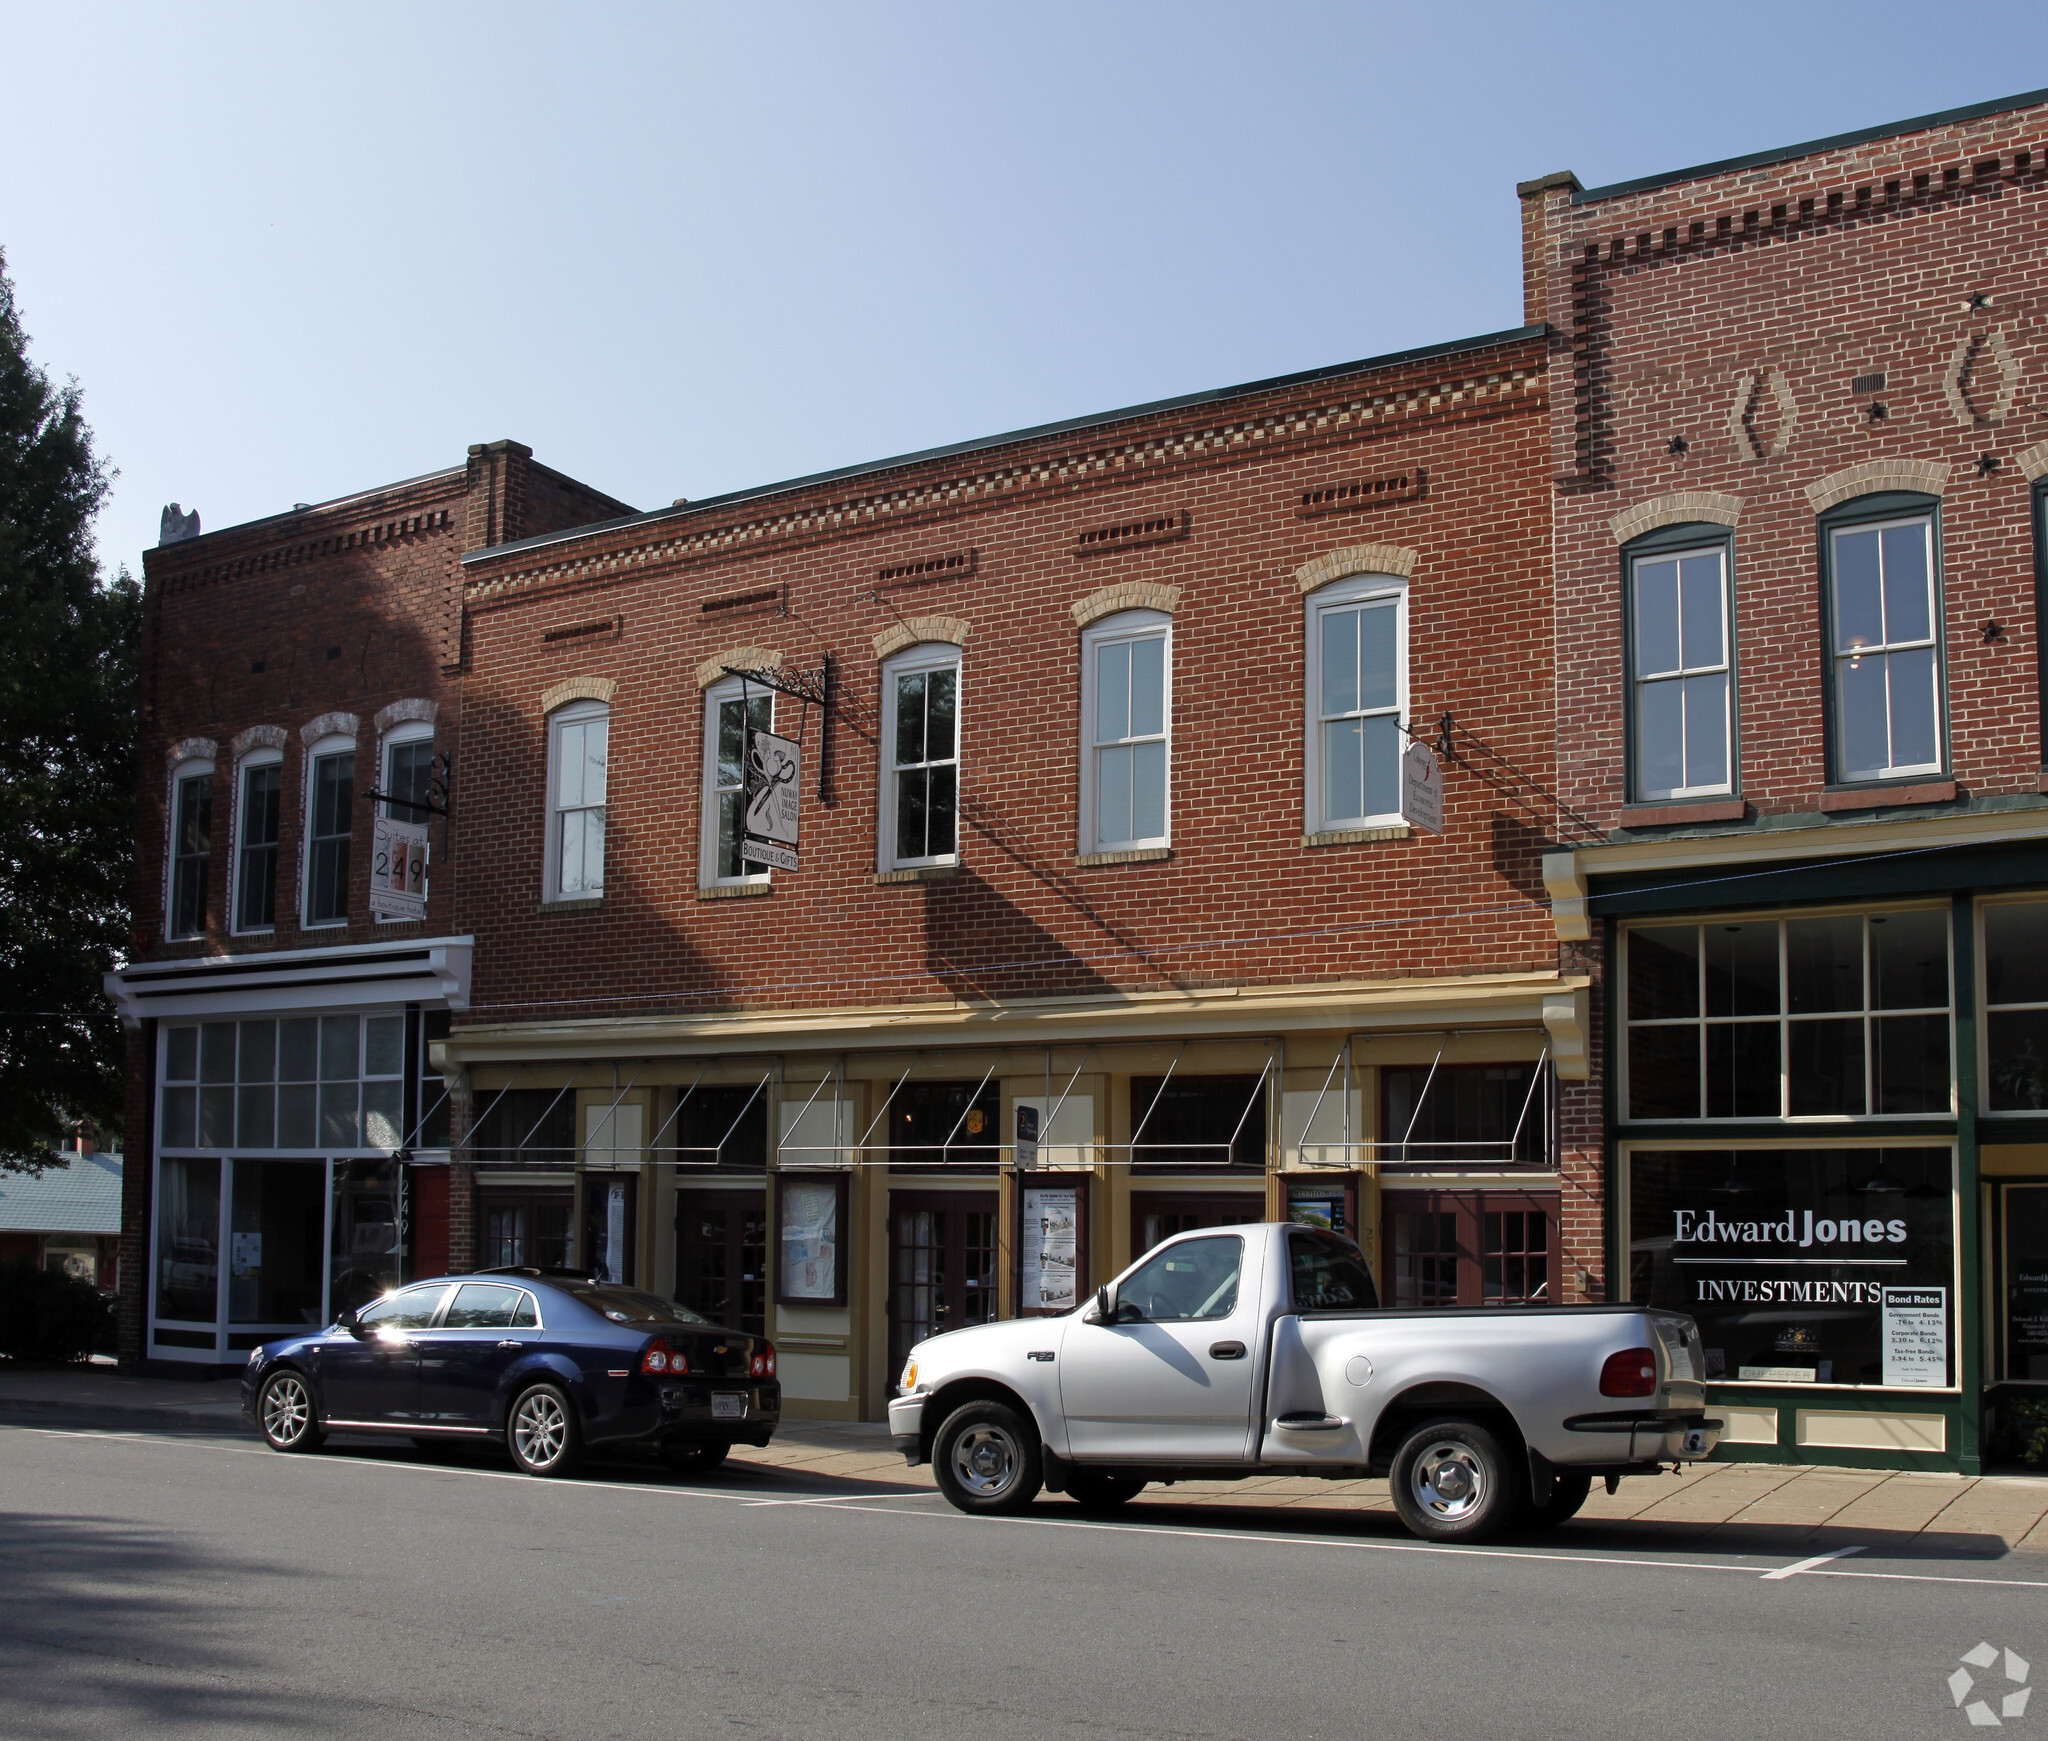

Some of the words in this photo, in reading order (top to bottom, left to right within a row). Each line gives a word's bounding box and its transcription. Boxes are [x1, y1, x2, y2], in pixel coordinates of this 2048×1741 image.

[781, 808, 797, 822] SALON
[782, 798, 797, 812] IMAGE
[376, 820, 410, 843] Suites
[412, 835, 424, 847] at
[376, 852, 422, 882] 249
[744, 842, 774, 862] BOUTIQUE
[775, 853, 780, 862] &
[780, 852, 798, 868] GIFTS
[378, 896, 405, 912] boutique
[401, 1180, 409, 1235] 249
[1697, 1280, 1881, 1304] INVESTMENTS
[1888, 1295, 1911, 1303] Bond
[1914, 1295, 1940, 1304] Rates
